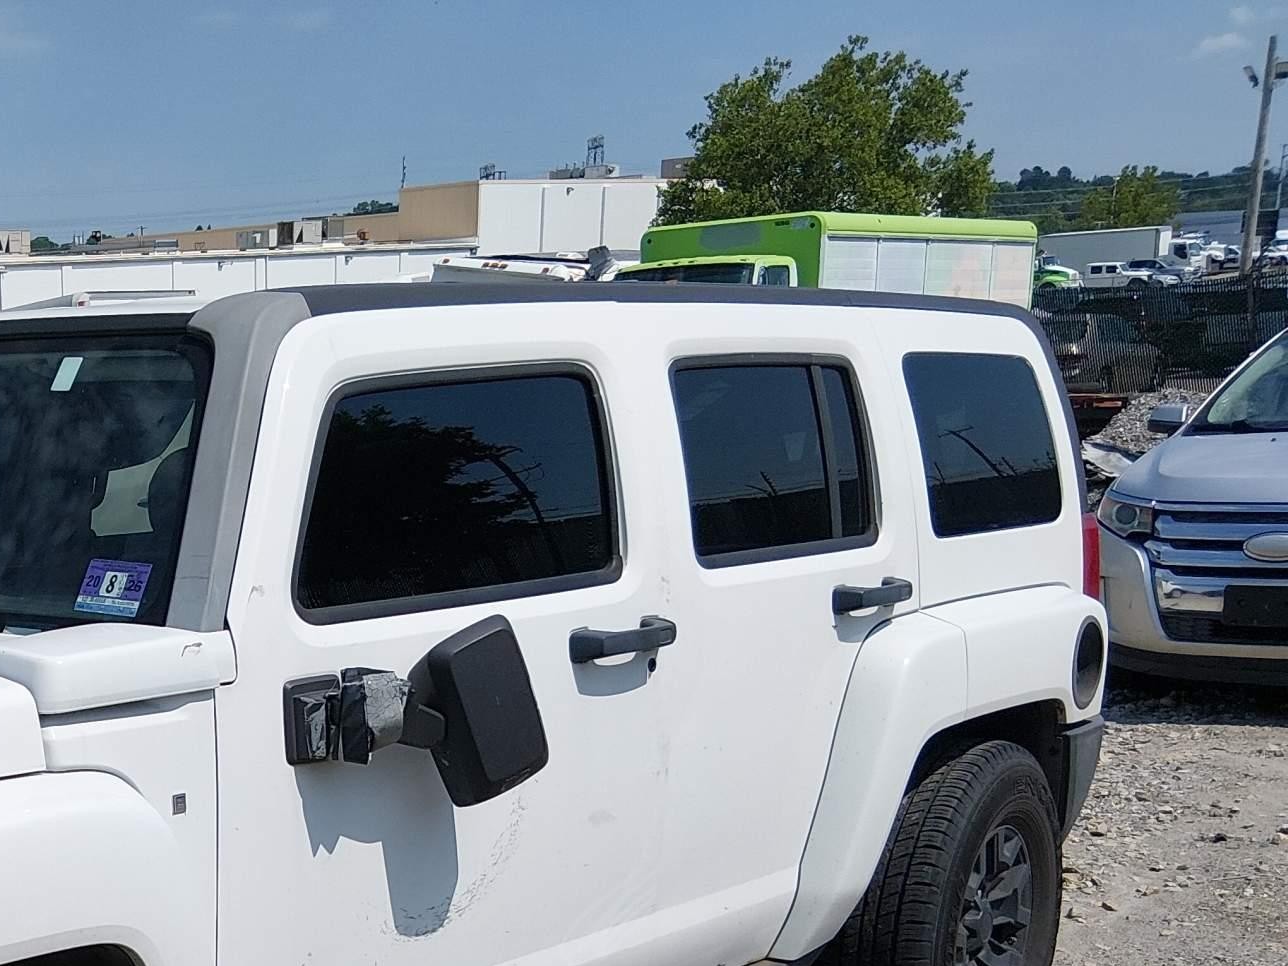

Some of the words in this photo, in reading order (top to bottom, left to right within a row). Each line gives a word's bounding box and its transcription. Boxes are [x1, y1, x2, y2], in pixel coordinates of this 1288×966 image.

[86, 575, 101, 588] 20
[105, 574, 118, 594] 8
[127, 580, 143, 593] 26
